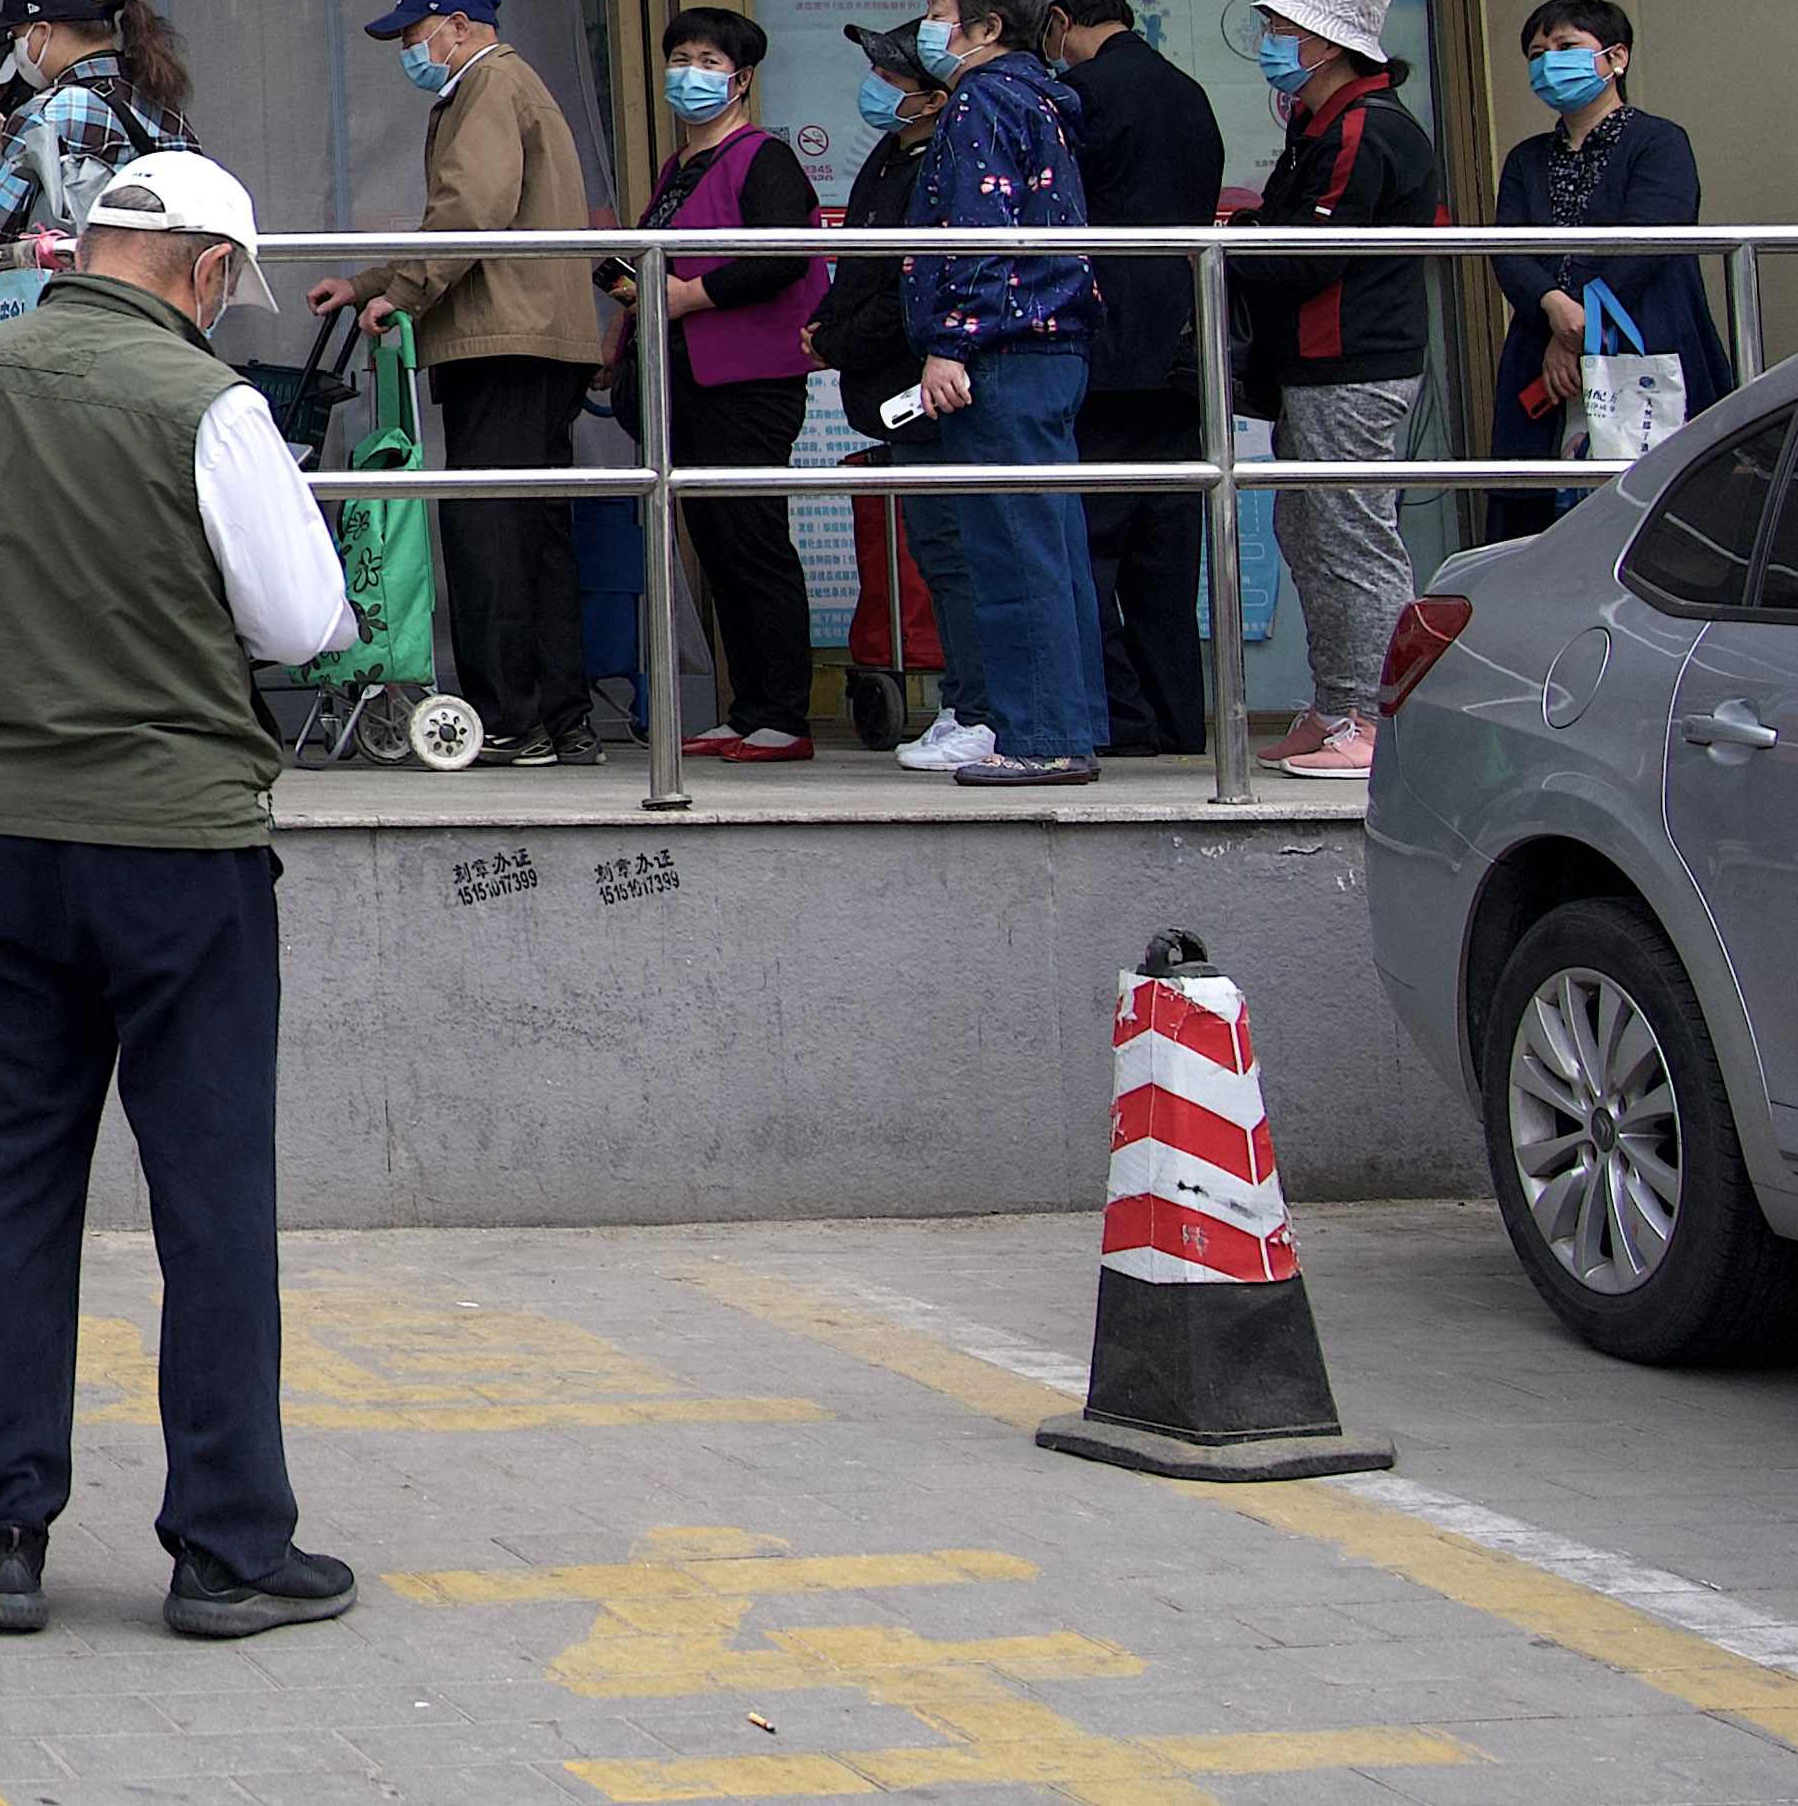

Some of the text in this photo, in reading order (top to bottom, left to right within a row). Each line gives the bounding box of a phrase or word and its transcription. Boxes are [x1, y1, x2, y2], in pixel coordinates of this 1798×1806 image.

[453, 848, 533, 885] 刻章办证
[594, 849, 675, 885] 刻章办证
